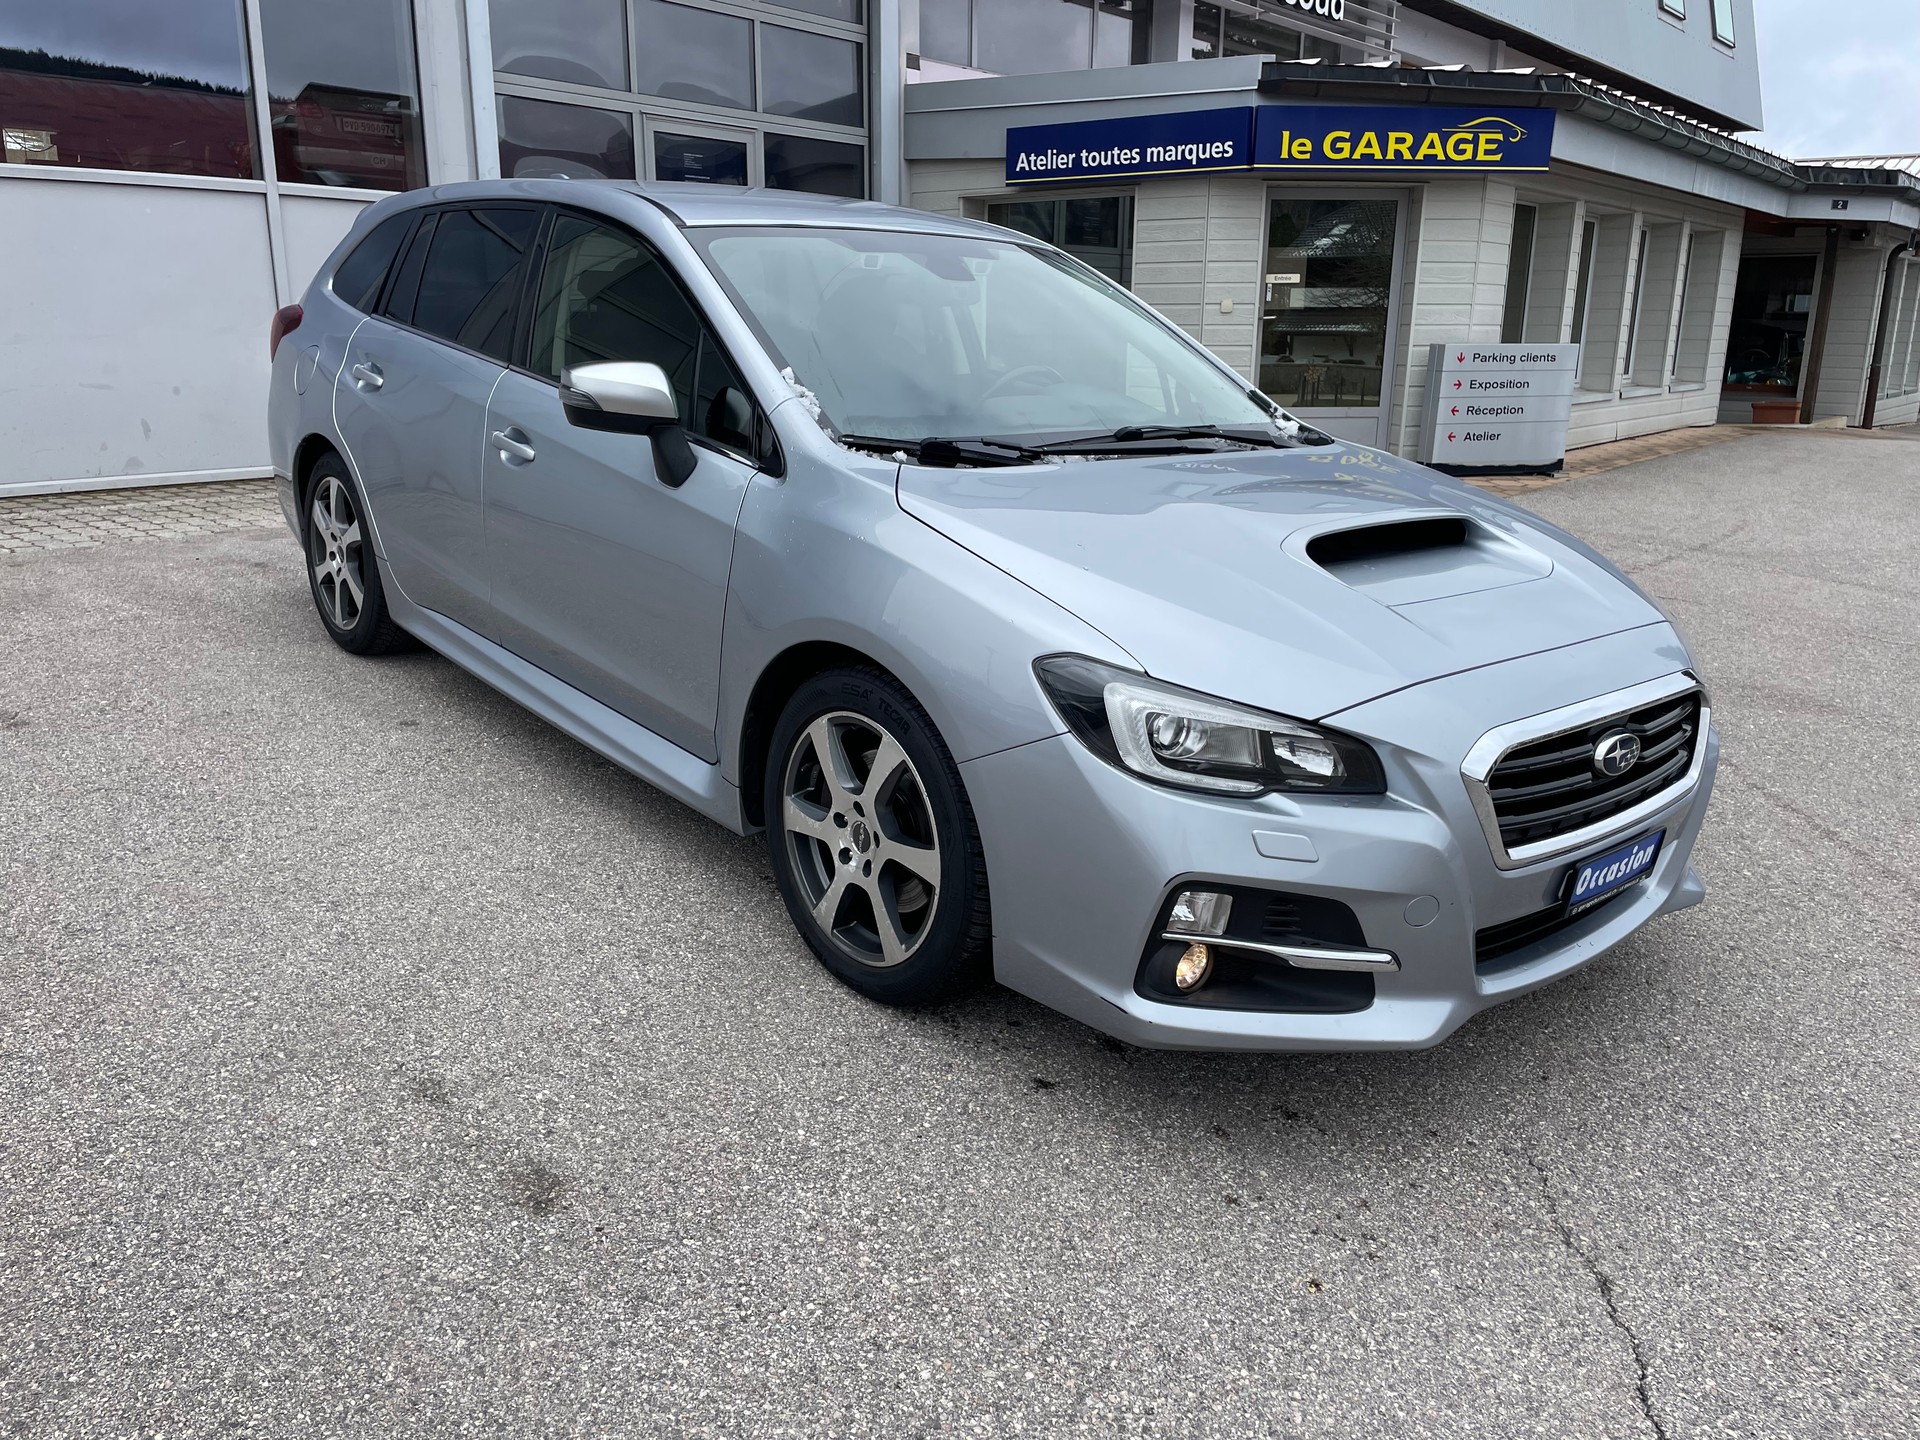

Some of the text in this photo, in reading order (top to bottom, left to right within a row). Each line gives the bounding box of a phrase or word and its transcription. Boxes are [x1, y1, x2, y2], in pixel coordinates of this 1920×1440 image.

[1280, 130, 1504, 161] le GARAGE
[373, 156, 386, 165] CH
[1015, 140, 1234, 171] Atelier toutes marques
[1837, 201, 1844, 209] 2
[1472, 352, 1557, 365] Parking clients
[1469, 379, 1530, 391] Exposition
[1466, 405, 1524, 417] Réception
[1463, 432, 1502, 442] Atelier
[878, 697, 912, 736] TECAR
[1575, 844, 1655, 896] Occasion
